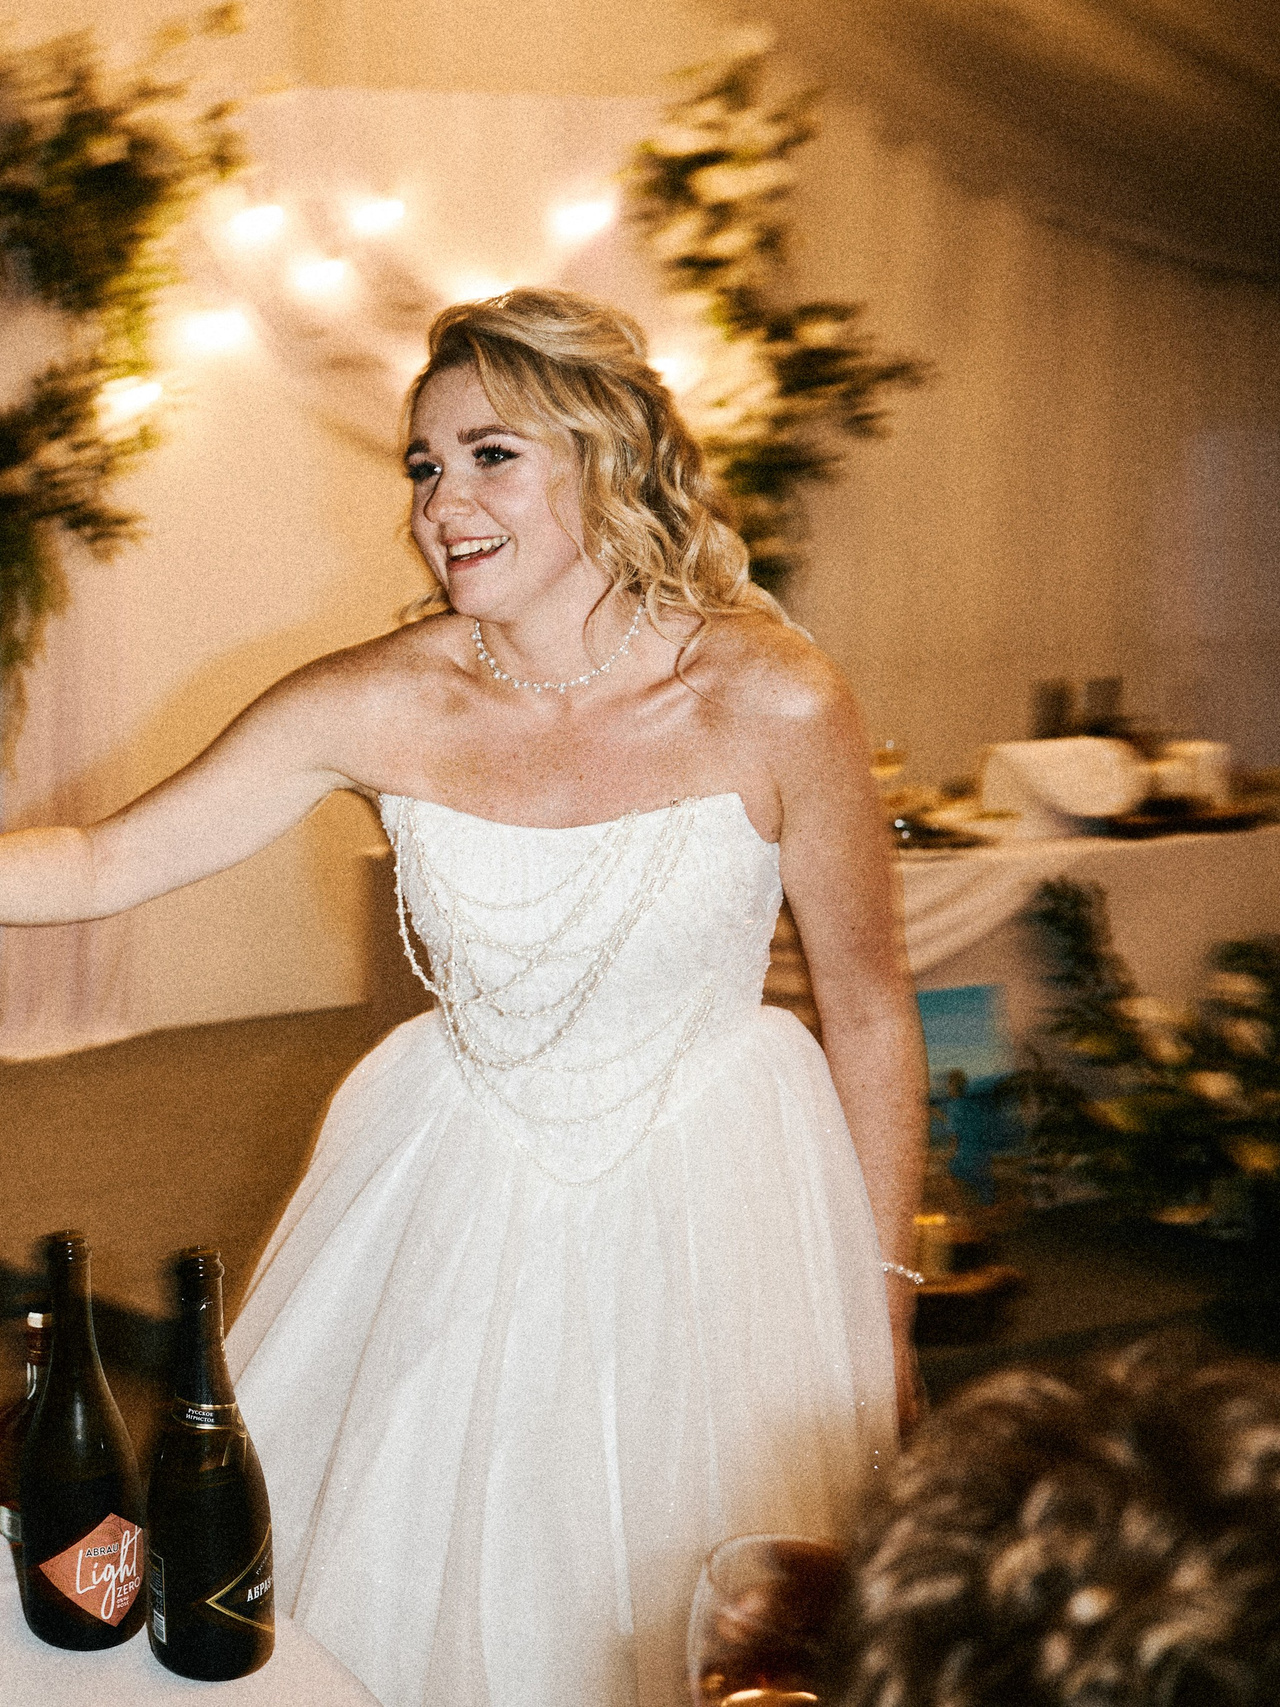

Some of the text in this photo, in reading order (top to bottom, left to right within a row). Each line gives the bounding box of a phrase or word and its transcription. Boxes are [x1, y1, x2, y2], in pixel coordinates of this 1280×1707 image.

[85, 1542, 120, 1558] ABRAU
[76, 1525, 142, 1620] Light
[116, 1576, 141, 1598] ZERO
